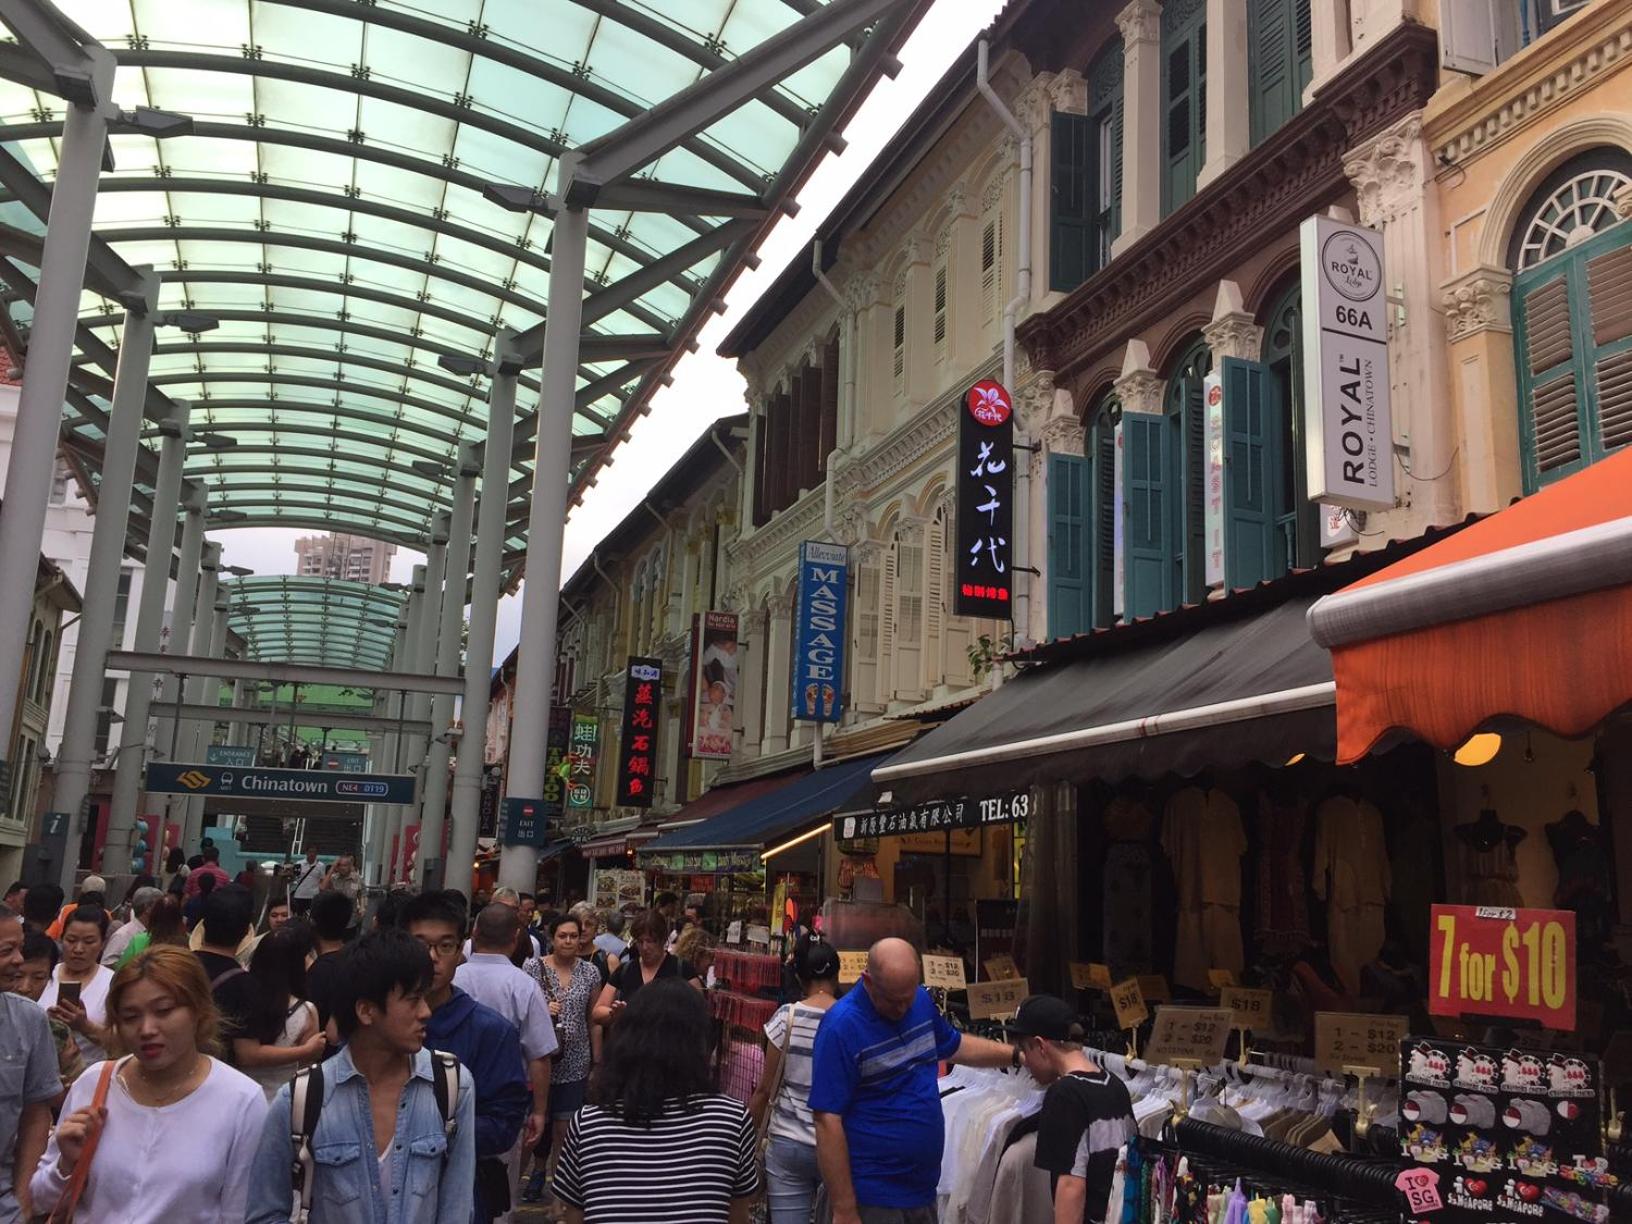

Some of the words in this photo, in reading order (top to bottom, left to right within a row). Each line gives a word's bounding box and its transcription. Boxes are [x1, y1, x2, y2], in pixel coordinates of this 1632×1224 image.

[1331, 261, 1372, 281] ROYAL
[1335, 305, 1373, 331] 66A
[1365, 358, 1376, 435] CHINATOWN
[1341, 357, 1365, 485] ROYAL
[1368, 450, 1378, 488] LODGE
[805, 567, 840, 681] MASSAGE
[241, 775, 328, 793] Chinatown
[342, 784, 358, 792] NE4
[363, 784, 385, 793] DT19
[979, 798, 1009, 822] TEL:
[1011, 794, 1029, 817] 63
[519, 820, 534, 828] EXIT
[945, 961, 960, 970] $12
[1438, 915, 1456, 998] 7
[1459, 942, 1496, 1002] for
[1502, 920, 1567, 1010] $10
[982, 991, 1015, 1004] $18
[1230, 999, 1261, 1012] $18
[1169, 1018, 1174, 1028] 1
[1193, 1022, 1217, 1032] $12
[1191, 1034, 1212, 1044] $20
[1335, 1027, 1342, 1037] 1
[1367, 1029, 1395, 1040] $12
[1333, 1041, 1344, 1052] 2
[1367, 1043, 1396, 1054] $20
[1404, 1176, 1417, 1191] I
